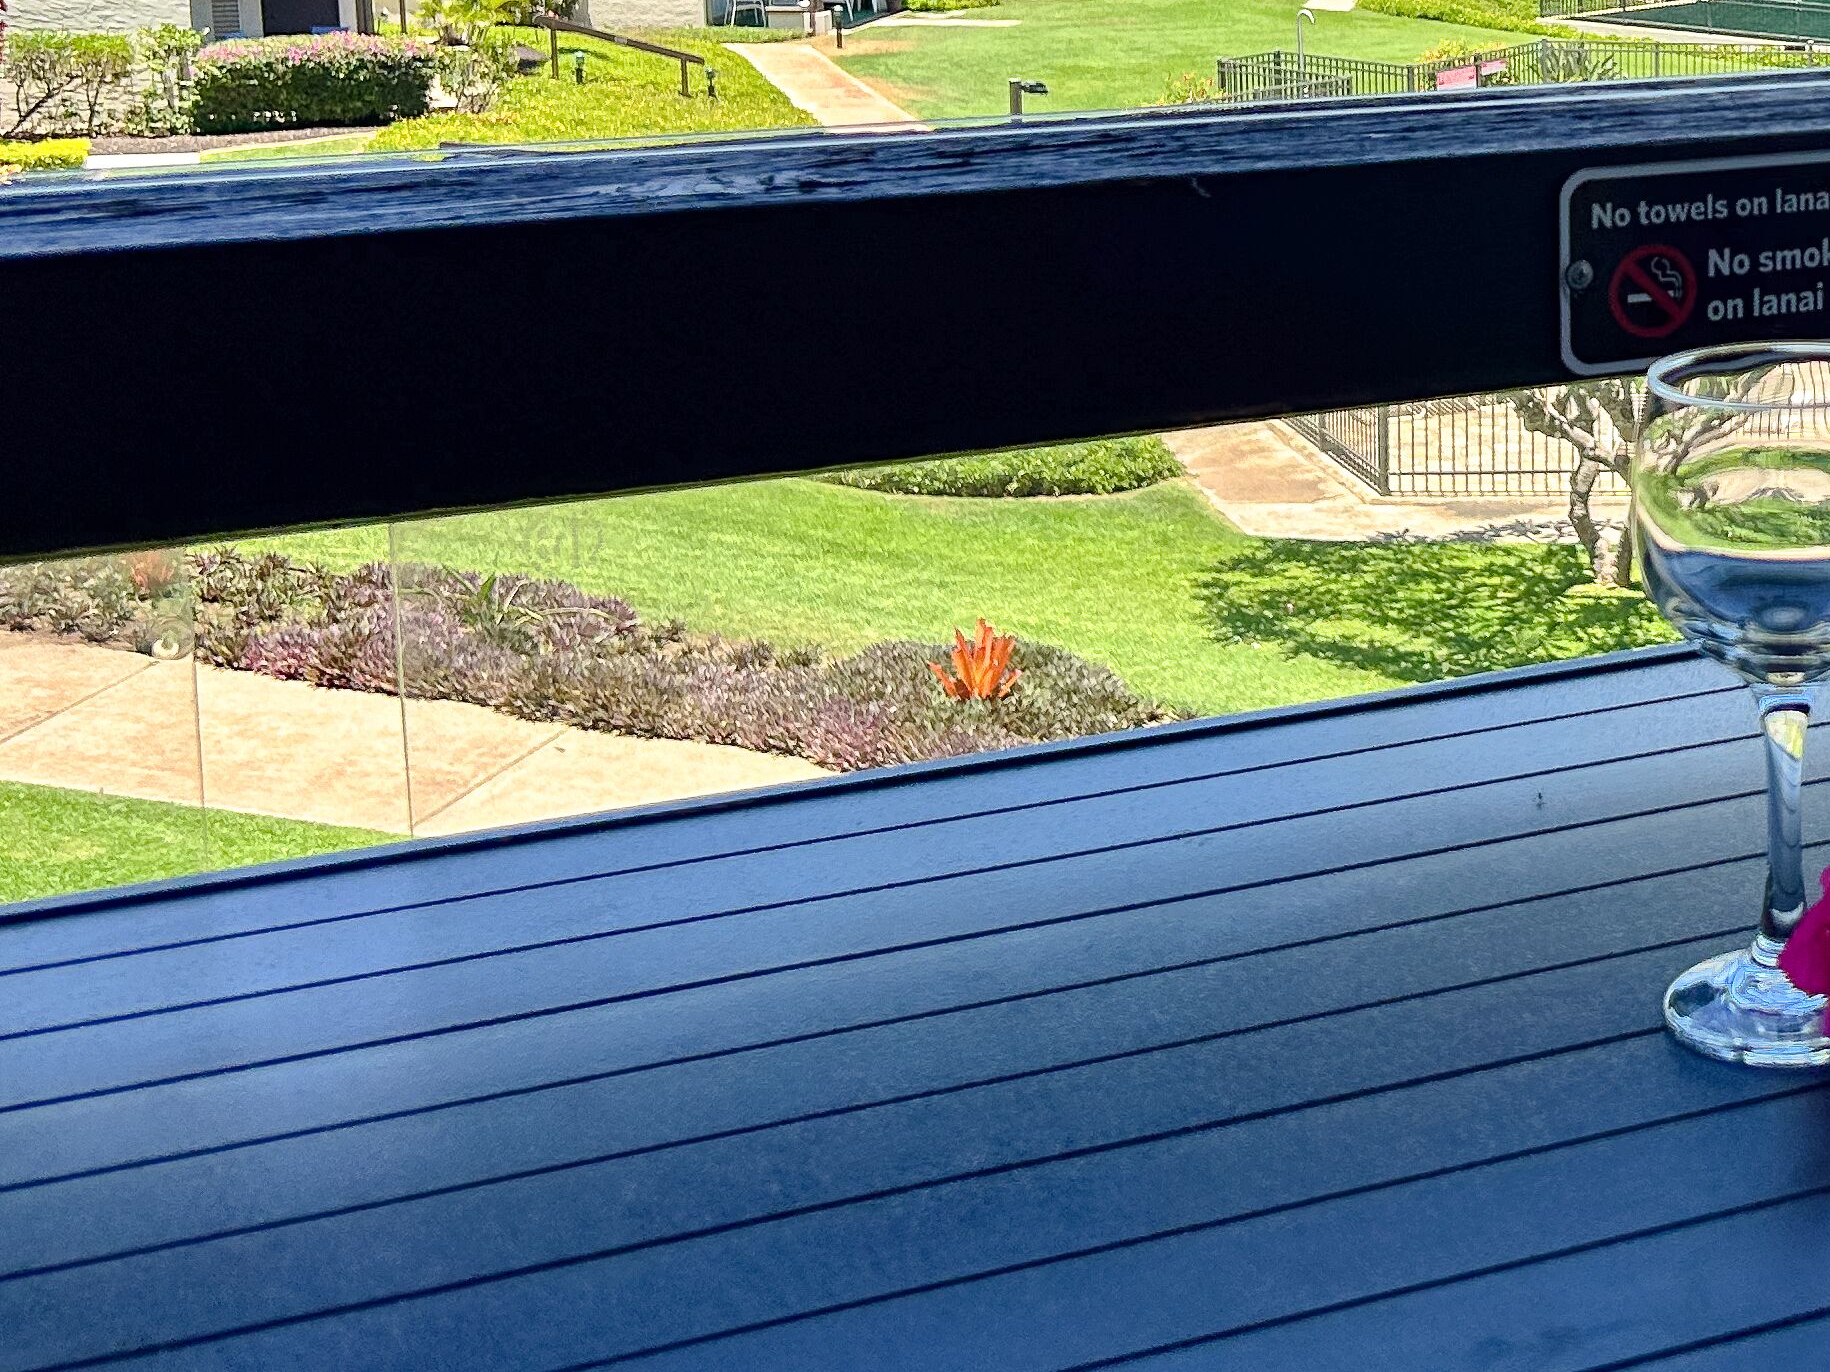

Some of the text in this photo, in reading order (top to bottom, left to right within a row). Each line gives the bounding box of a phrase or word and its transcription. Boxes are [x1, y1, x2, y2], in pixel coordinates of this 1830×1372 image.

[1591, 202, 1631, 230] No
[1637, 193, 1728, 226] towels
[1735, 196, 1769, 217] on
[1707, 247, 1751, 278] No
[1707, 281, 1825, 322] on lanai
